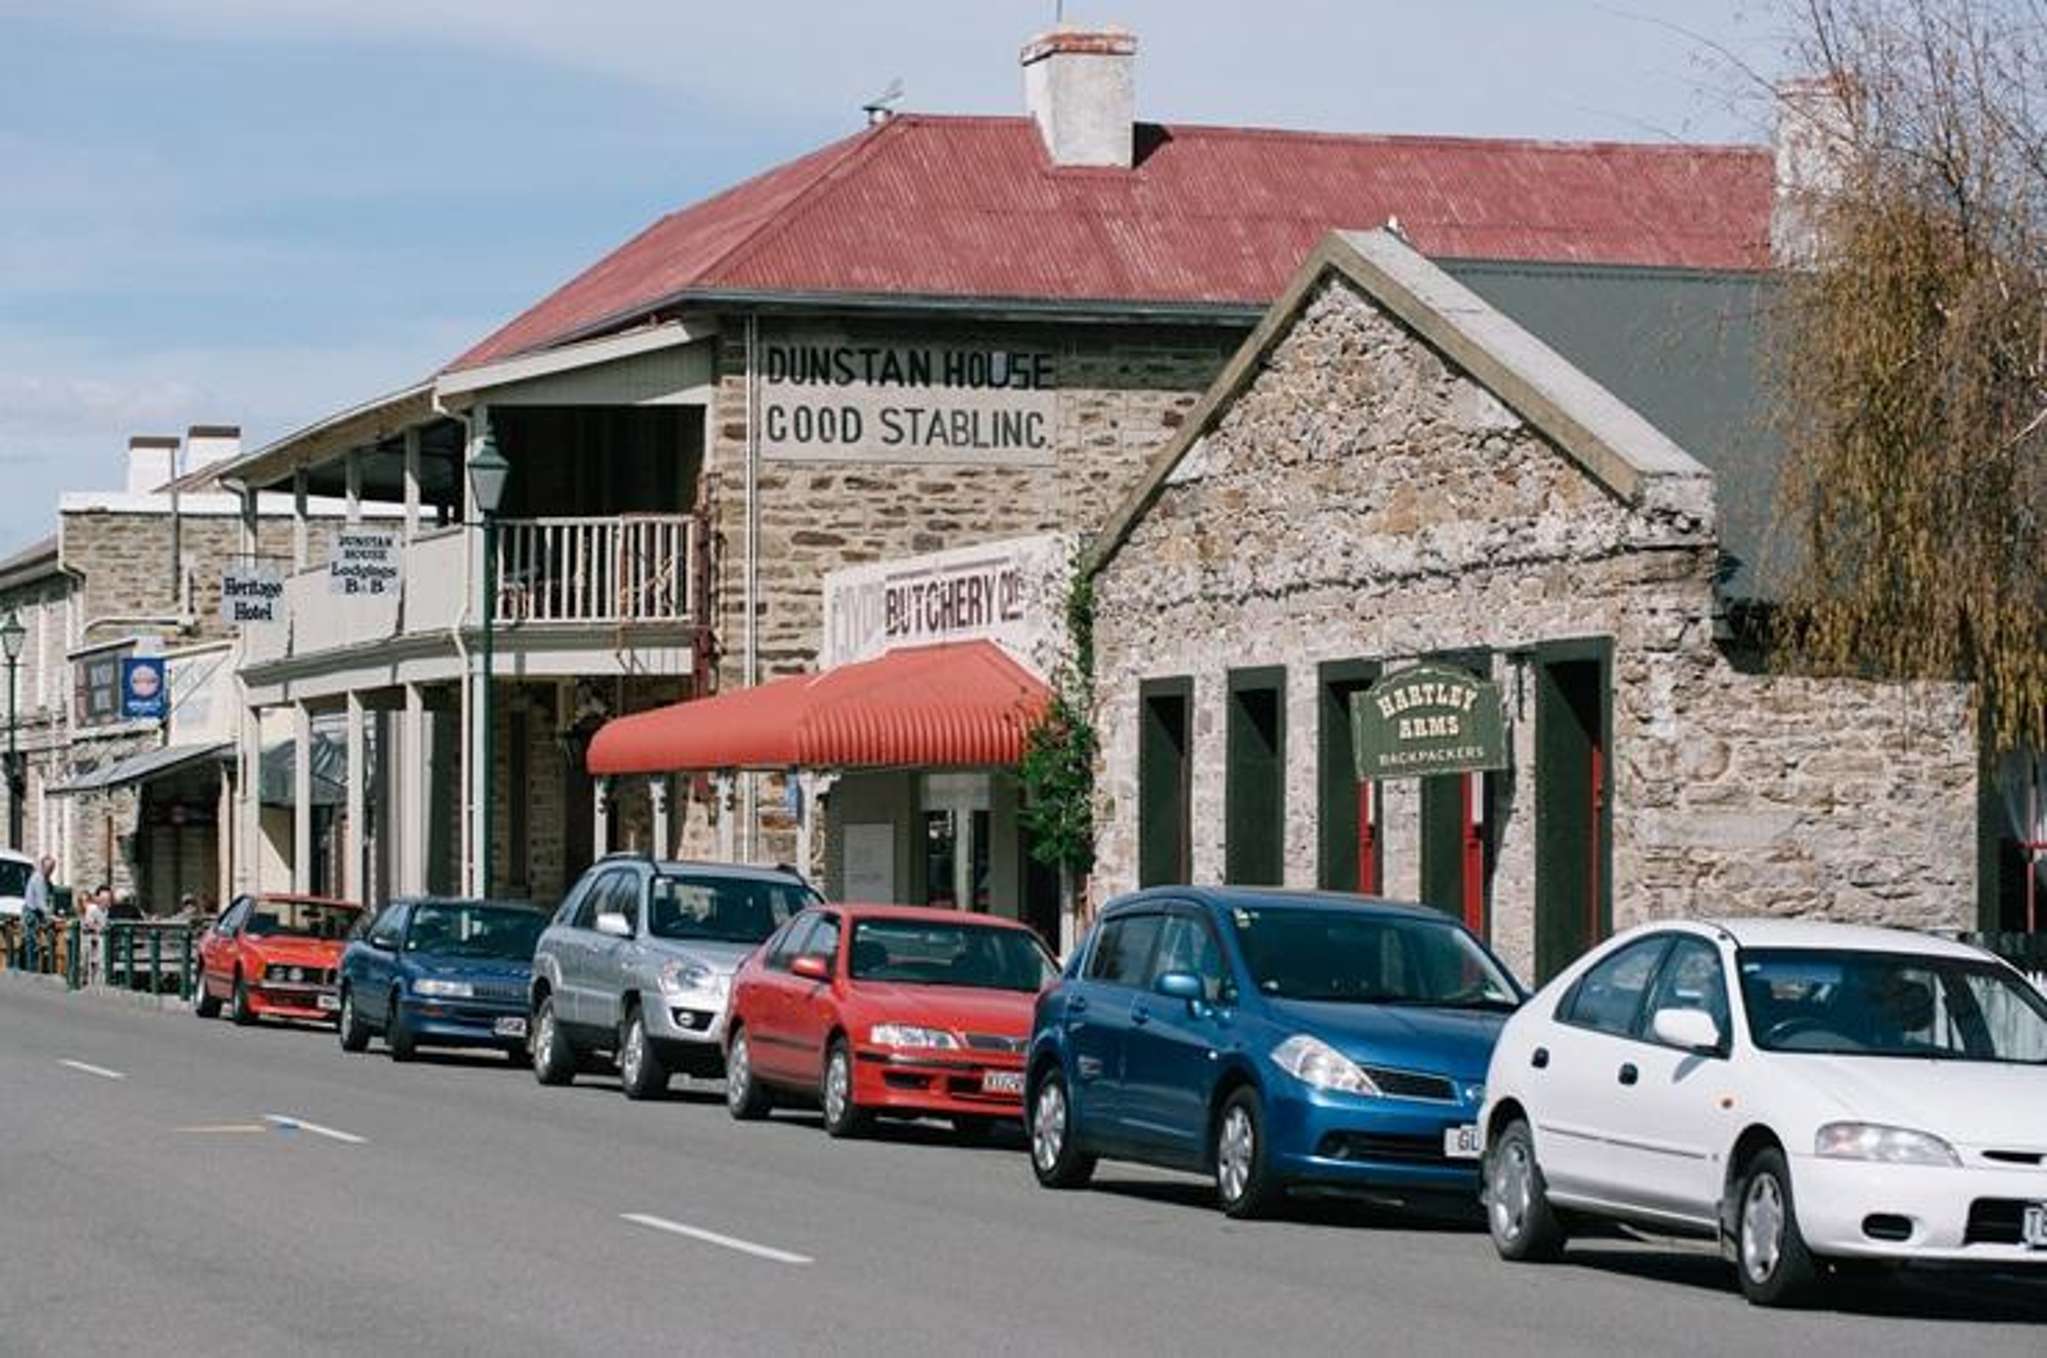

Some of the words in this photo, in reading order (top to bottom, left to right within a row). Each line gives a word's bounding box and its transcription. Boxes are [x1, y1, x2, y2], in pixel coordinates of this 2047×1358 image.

[767, 346, 931, 387] DUNSTAN
[944, 351, 1054, 391] HOUSE
[331, 560, 397, 579] Lodgings
[223, 577, 283, 598] Heritage
[234, 601, 273, 621] Hotel
[886, 573, 996, 636] BUTCHERY
[1376, 682, 1478, 719] HARTLEY
[1399, 715, 1460, 739] ARMS
[1379, 746, 1485, 767] BACKPACKERS
